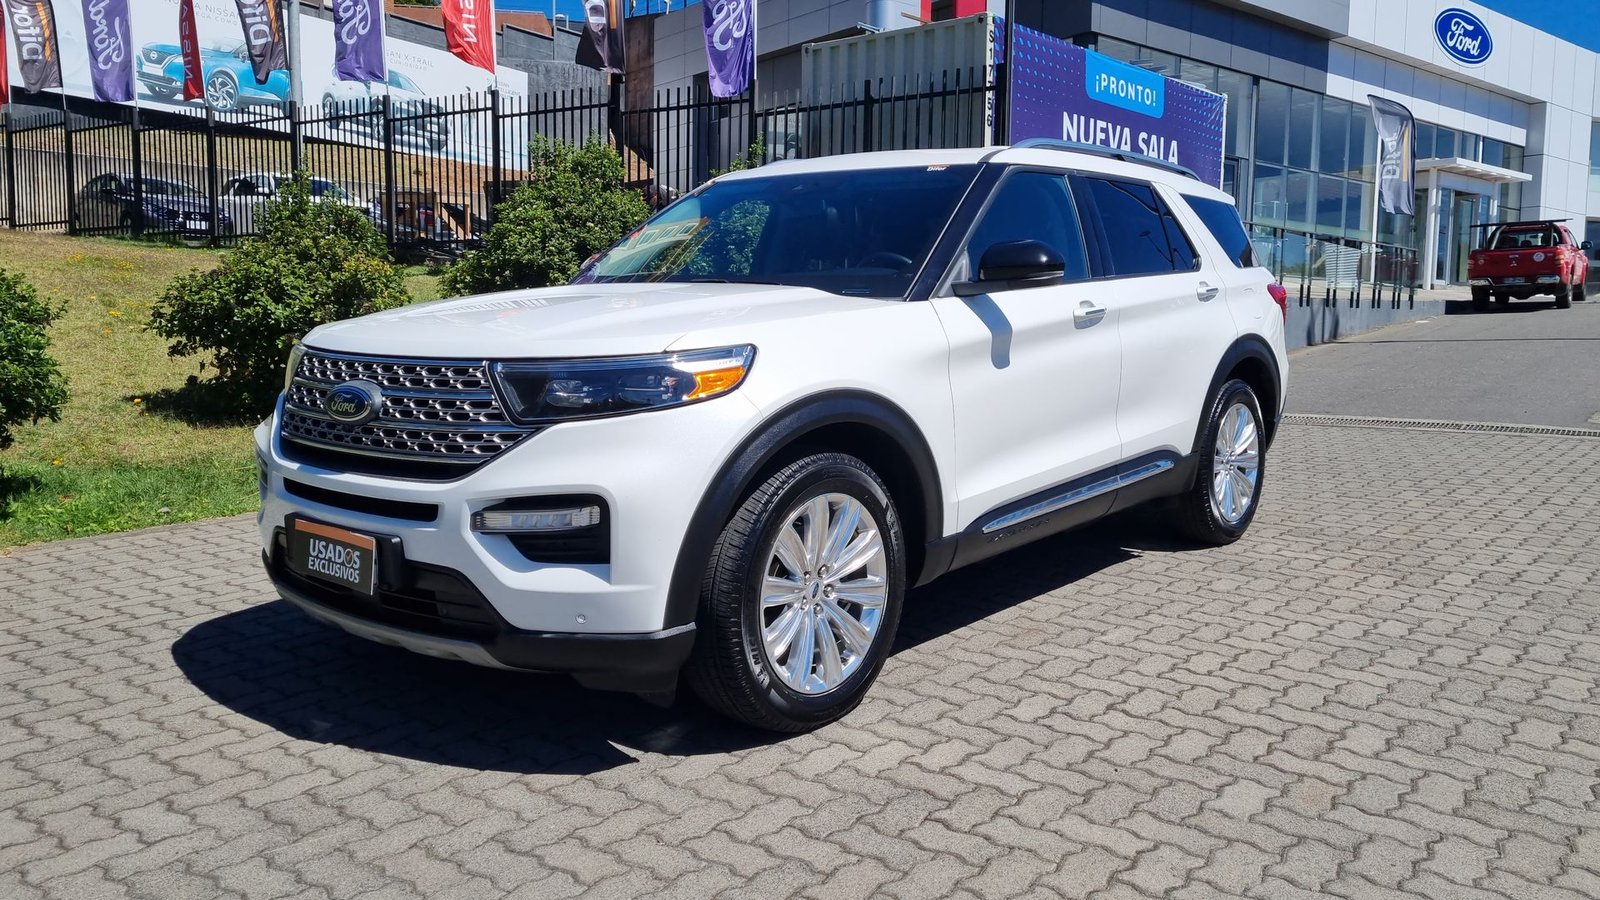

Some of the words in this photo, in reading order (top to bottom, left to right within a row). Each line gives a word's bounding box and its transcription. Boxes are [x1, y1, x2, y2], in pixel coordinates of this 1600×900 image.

[1446, 18, 1482, 56] Ford
[1095, 73, 1157, 107] ¡PRONTO!
[1062, 111, 1131, 151] NUEVA
[1138, 131, 1179, 165] SALA
[331, 392, 358, 413] Ford
[309, 538, 361, 569] USADOS
[308, 556, 360, 584] EXCLUSIVOS
